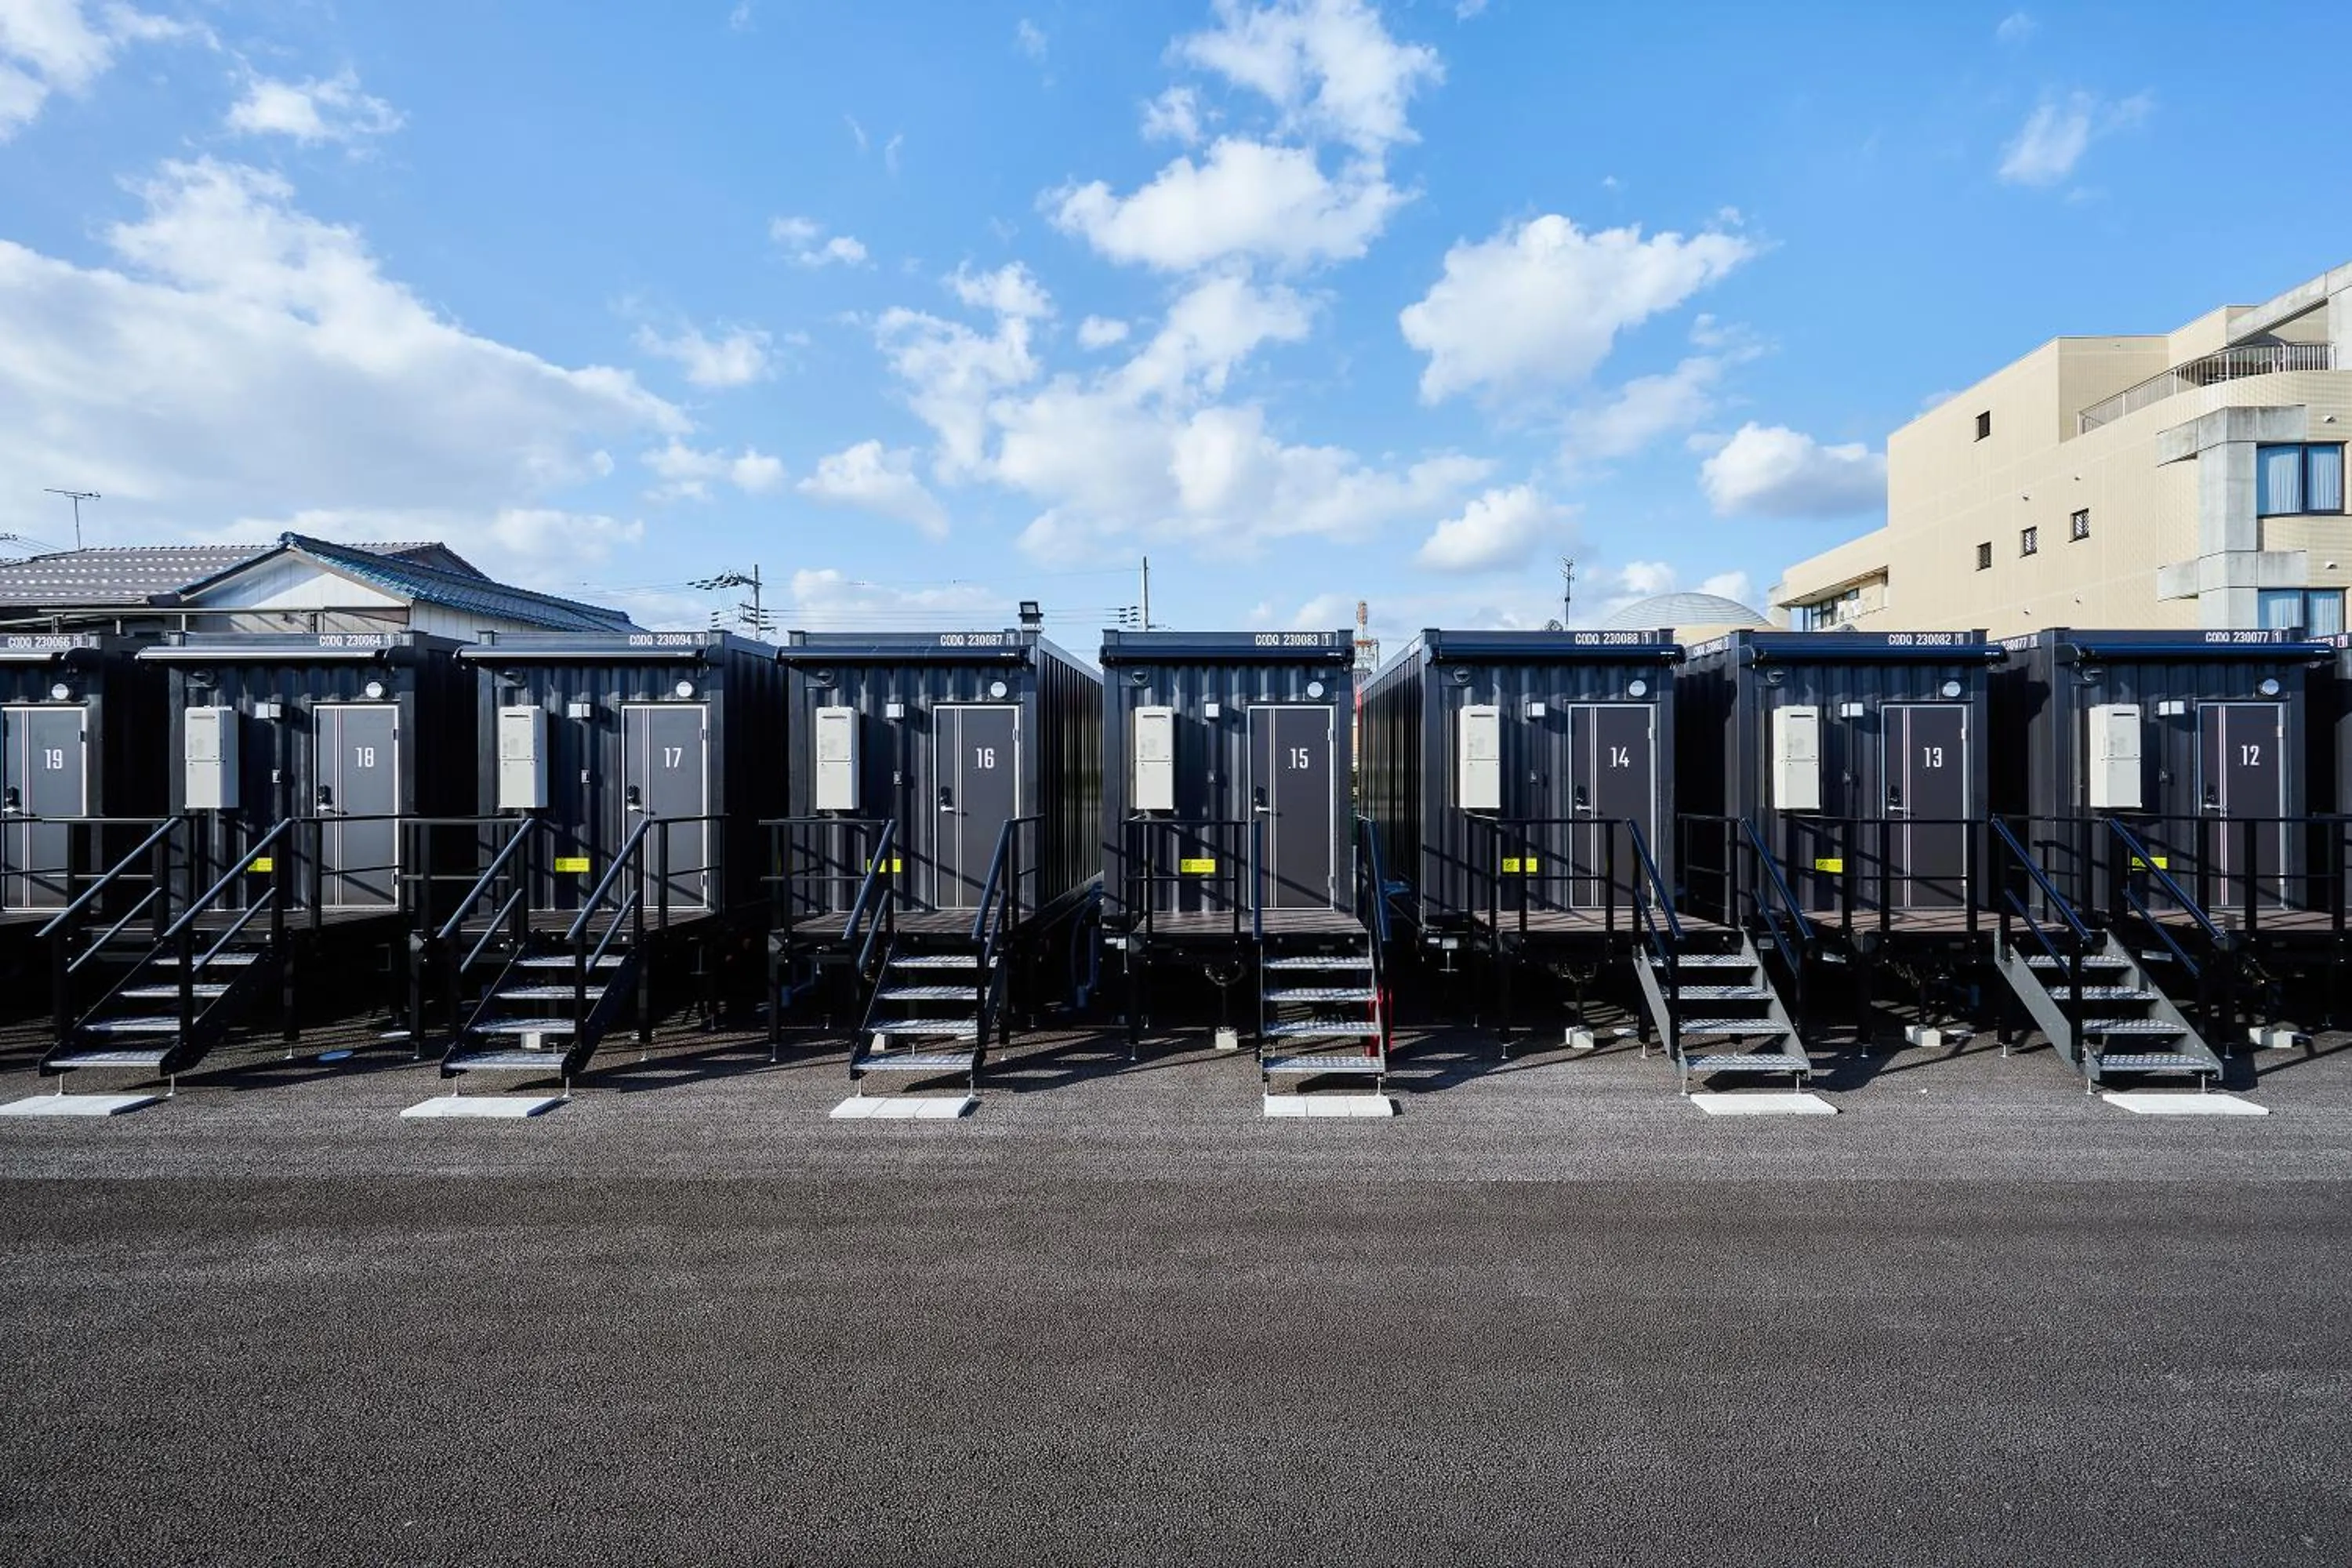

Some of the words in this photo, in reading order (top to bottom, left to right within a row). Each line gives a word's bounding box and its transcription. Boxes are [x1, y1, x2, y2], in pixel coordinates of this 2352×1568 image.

[2233, 631, 2269, 643] 230077
[44, 749, 64, 769] 19
[355, 747, 375, 768] 18
[664, 747, 683, 768] 17
[976, 747, 995, 769] 16
[1290, 747, 1309, 769] 15
[1610, 746, 1631, 768] 14
[1923, 746, 1943, 768] 13
[2241, 745, 2261, 766] 12
